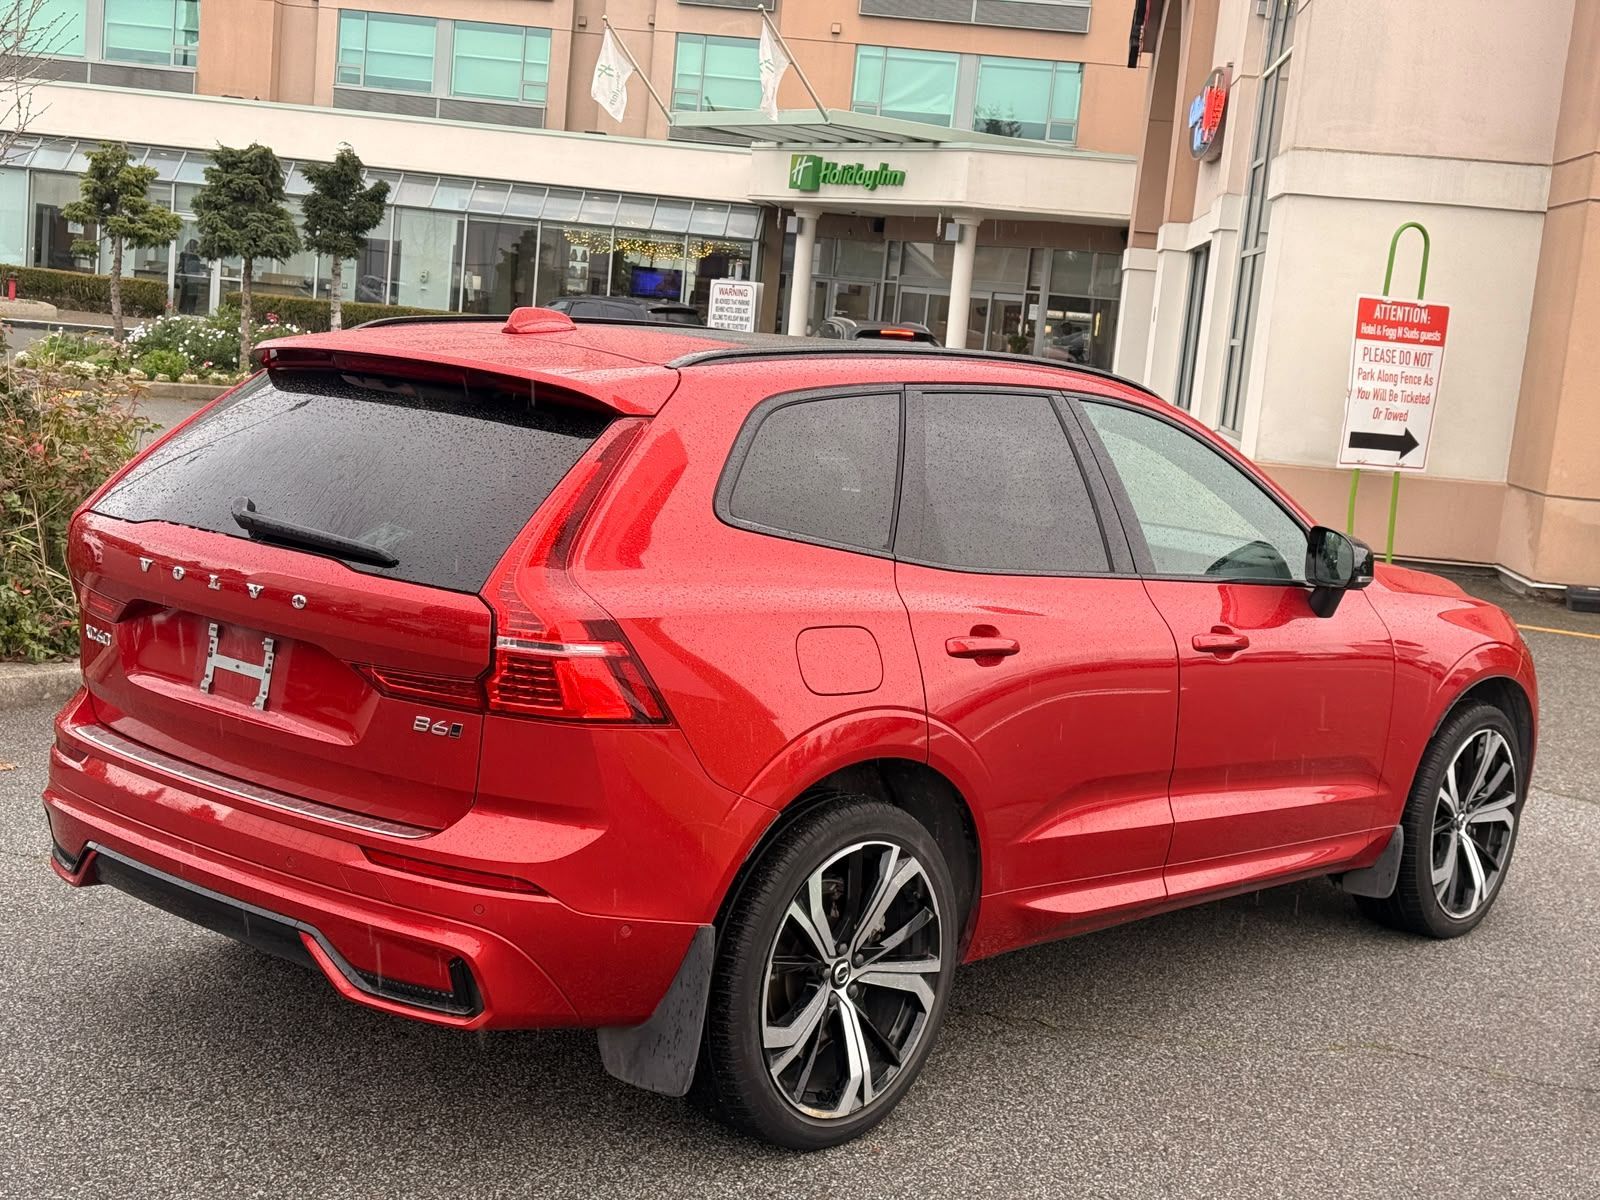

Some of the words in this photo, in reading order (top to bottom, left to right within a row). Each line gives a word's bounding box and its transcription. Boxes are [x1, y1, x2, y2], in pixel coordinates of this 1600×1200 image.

[819, 161, 877, 191] Holiday
[875, 162, 906, 187] Inn
[718, 287, 749, 298] WARNING
[1373, 303, 1431, 325] ATTENTION:
[1361, 321, 1376, 335] Hotel
[1377, 324, 1382, 336] &
[1403, 327, 1420, 339] Suds
[1419, 330, 1442, 343] guests
[1362, 346, 1397, 365] PLEASE
[1399, 350, 1411, 366] DO
[1413, 352, 1433, 368] NOT
[1357, 367, 1375, 382] Park
[1376, 369, 1398, 387] Along
[1400, 371, 1422, 386] Fence
[1423, 373, 1434, 386] As
[1356, 387, 1370, 401] You
[1372, 388, 1387, 402] Will
[1389, 390, 1399, 403] Be
[1400, 390, 1431, 405] Ticketed
[1372, 406, 1383, 420] Or
[1384, 407, 1409, 422] Towed
[138, 556, 307, 610] VOLVO
[413, 715, 449, 736] B6
